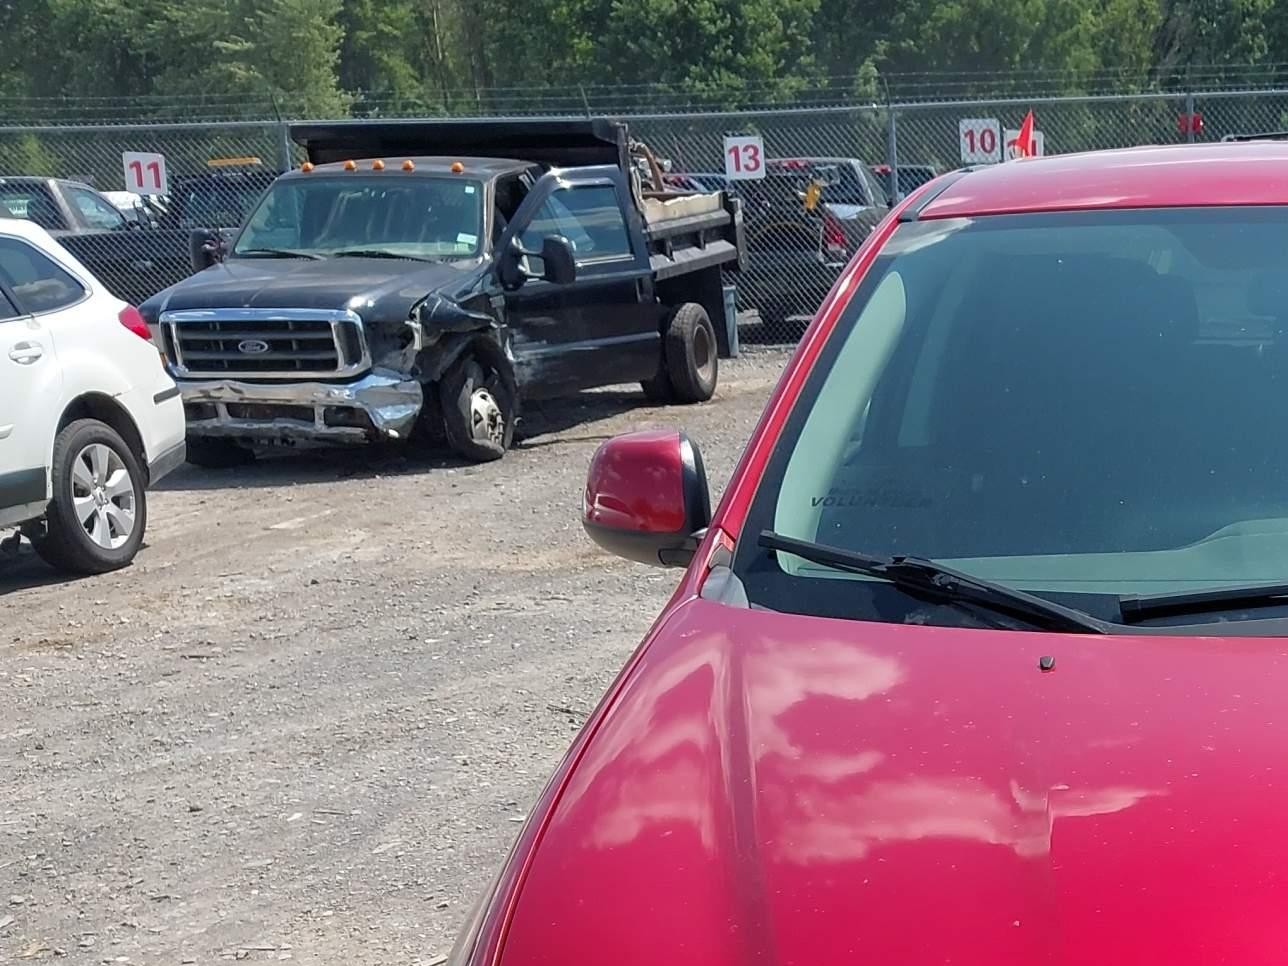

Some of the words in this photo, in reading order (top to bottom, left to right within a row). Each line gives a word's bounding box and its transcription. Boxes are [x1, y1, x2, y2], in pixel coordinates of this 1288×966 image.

[964, 128, 996, 154] 10
[728, 144, 761, 173] 13
[129, 160, 161, 189] 11
